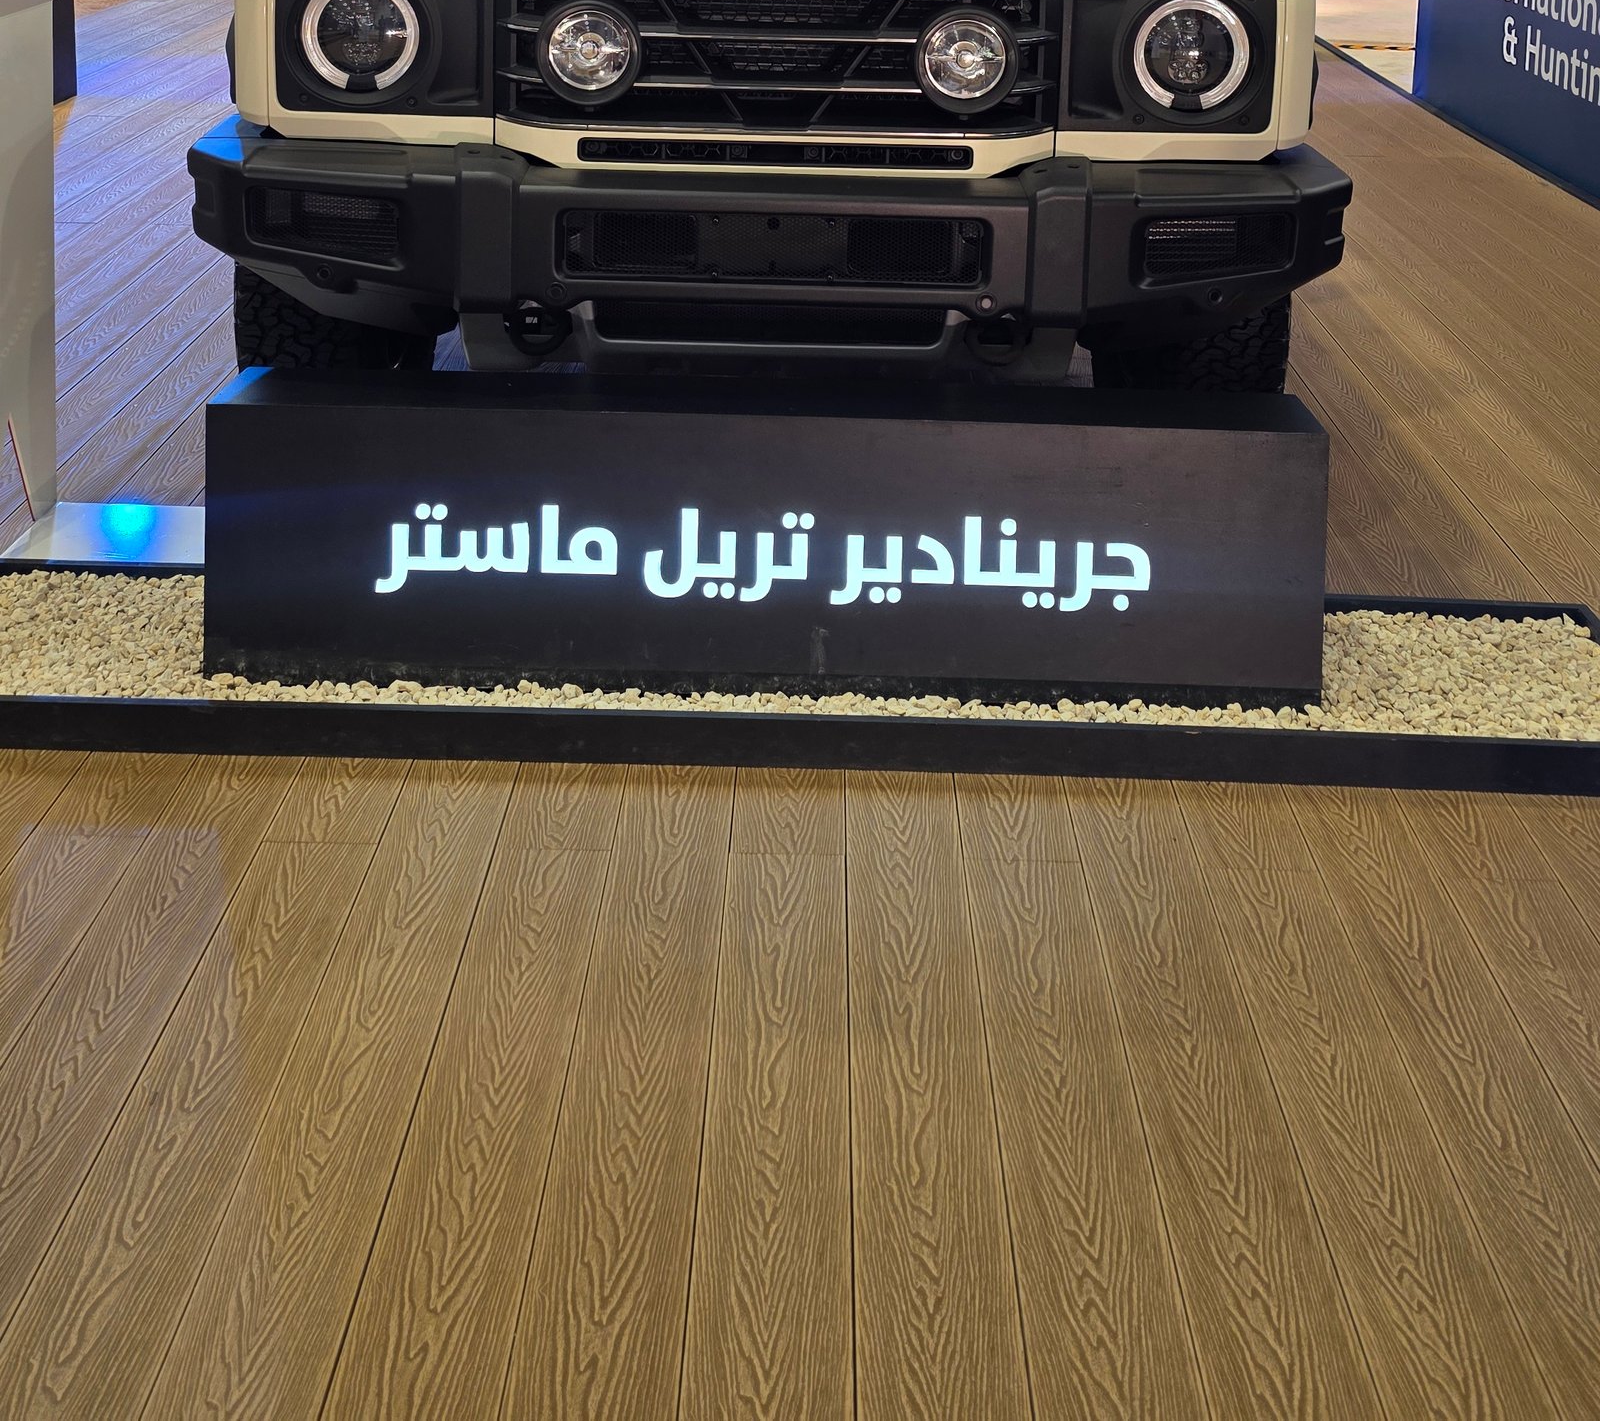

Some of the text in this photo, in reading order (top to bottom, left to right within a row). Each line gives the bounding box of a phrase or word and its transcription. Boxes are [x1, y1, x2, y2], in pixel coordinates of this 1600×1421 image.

[1502, 15, 1518, 66] &
[375, 503, 1151, 612] جرينادير تريل ماستر
